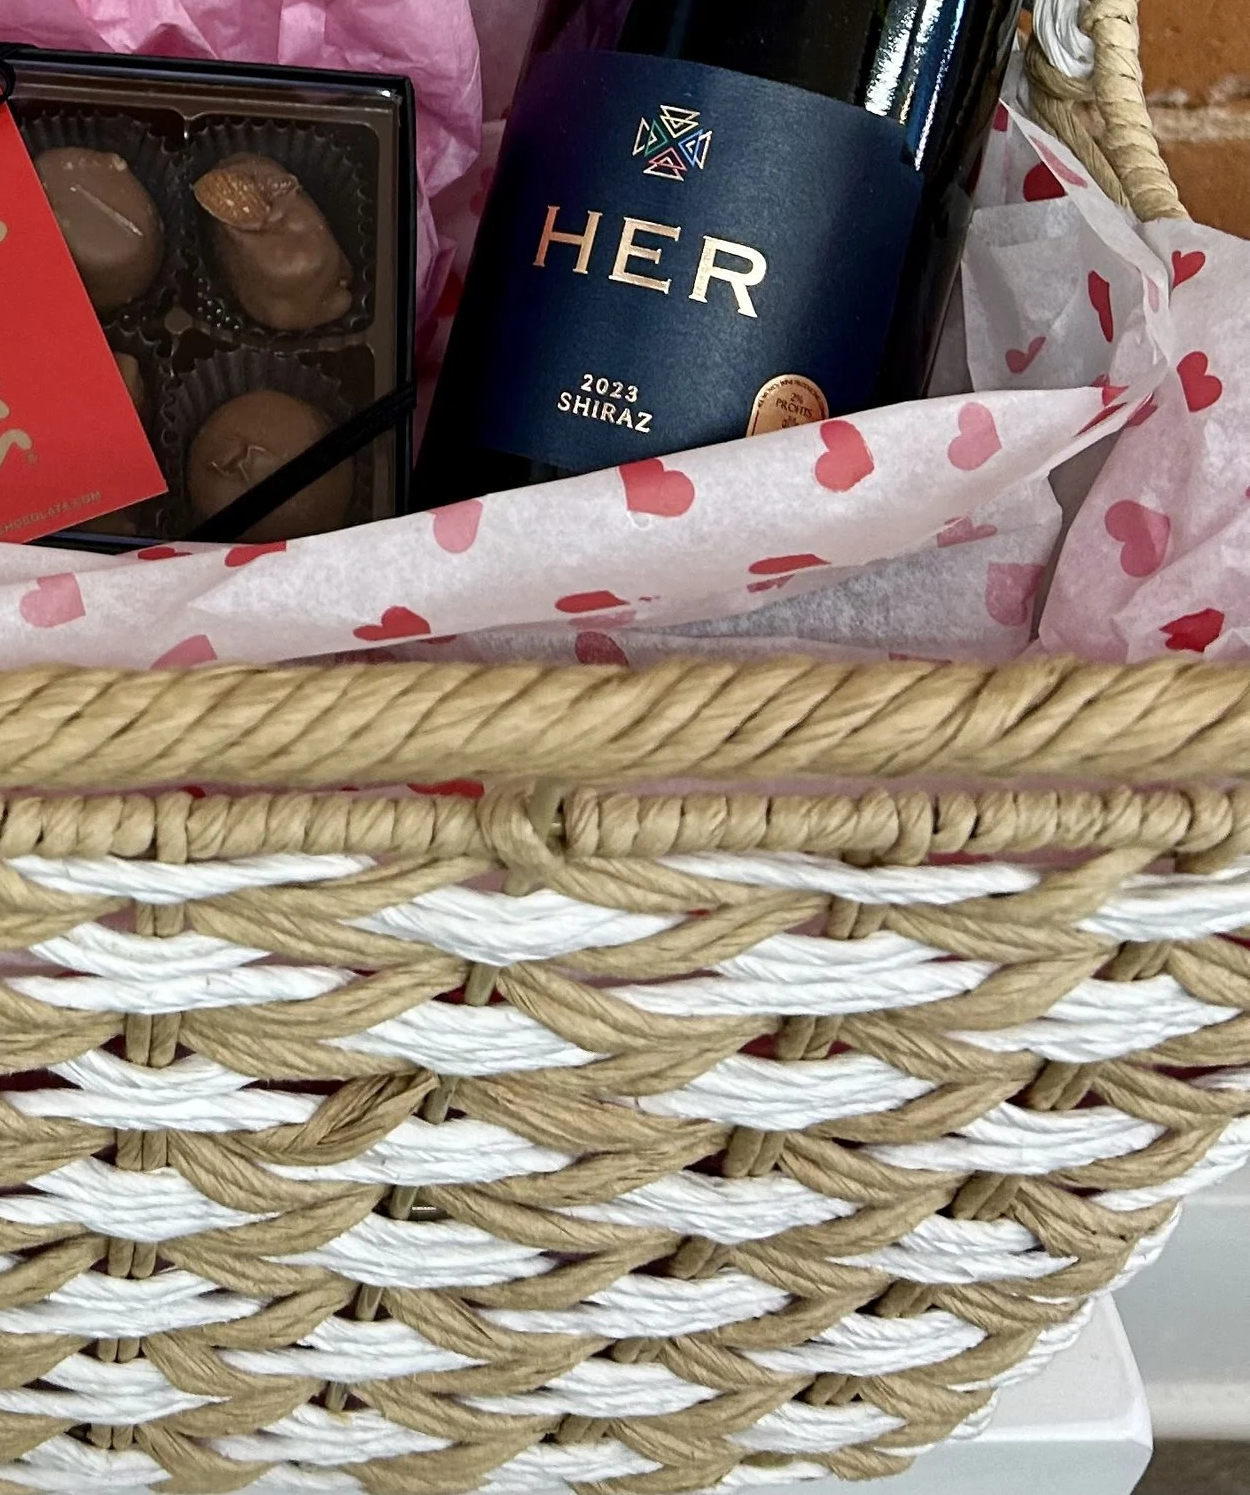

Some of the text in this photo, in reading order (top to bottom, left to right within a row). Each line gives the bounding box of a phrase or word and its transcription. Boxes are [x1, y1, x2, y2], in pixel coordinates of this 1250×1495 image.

[532, 205, 767, 318] HER
[580, 373, 639, 403] 2023
[557, 391, 653, 433] SHIRAZ
